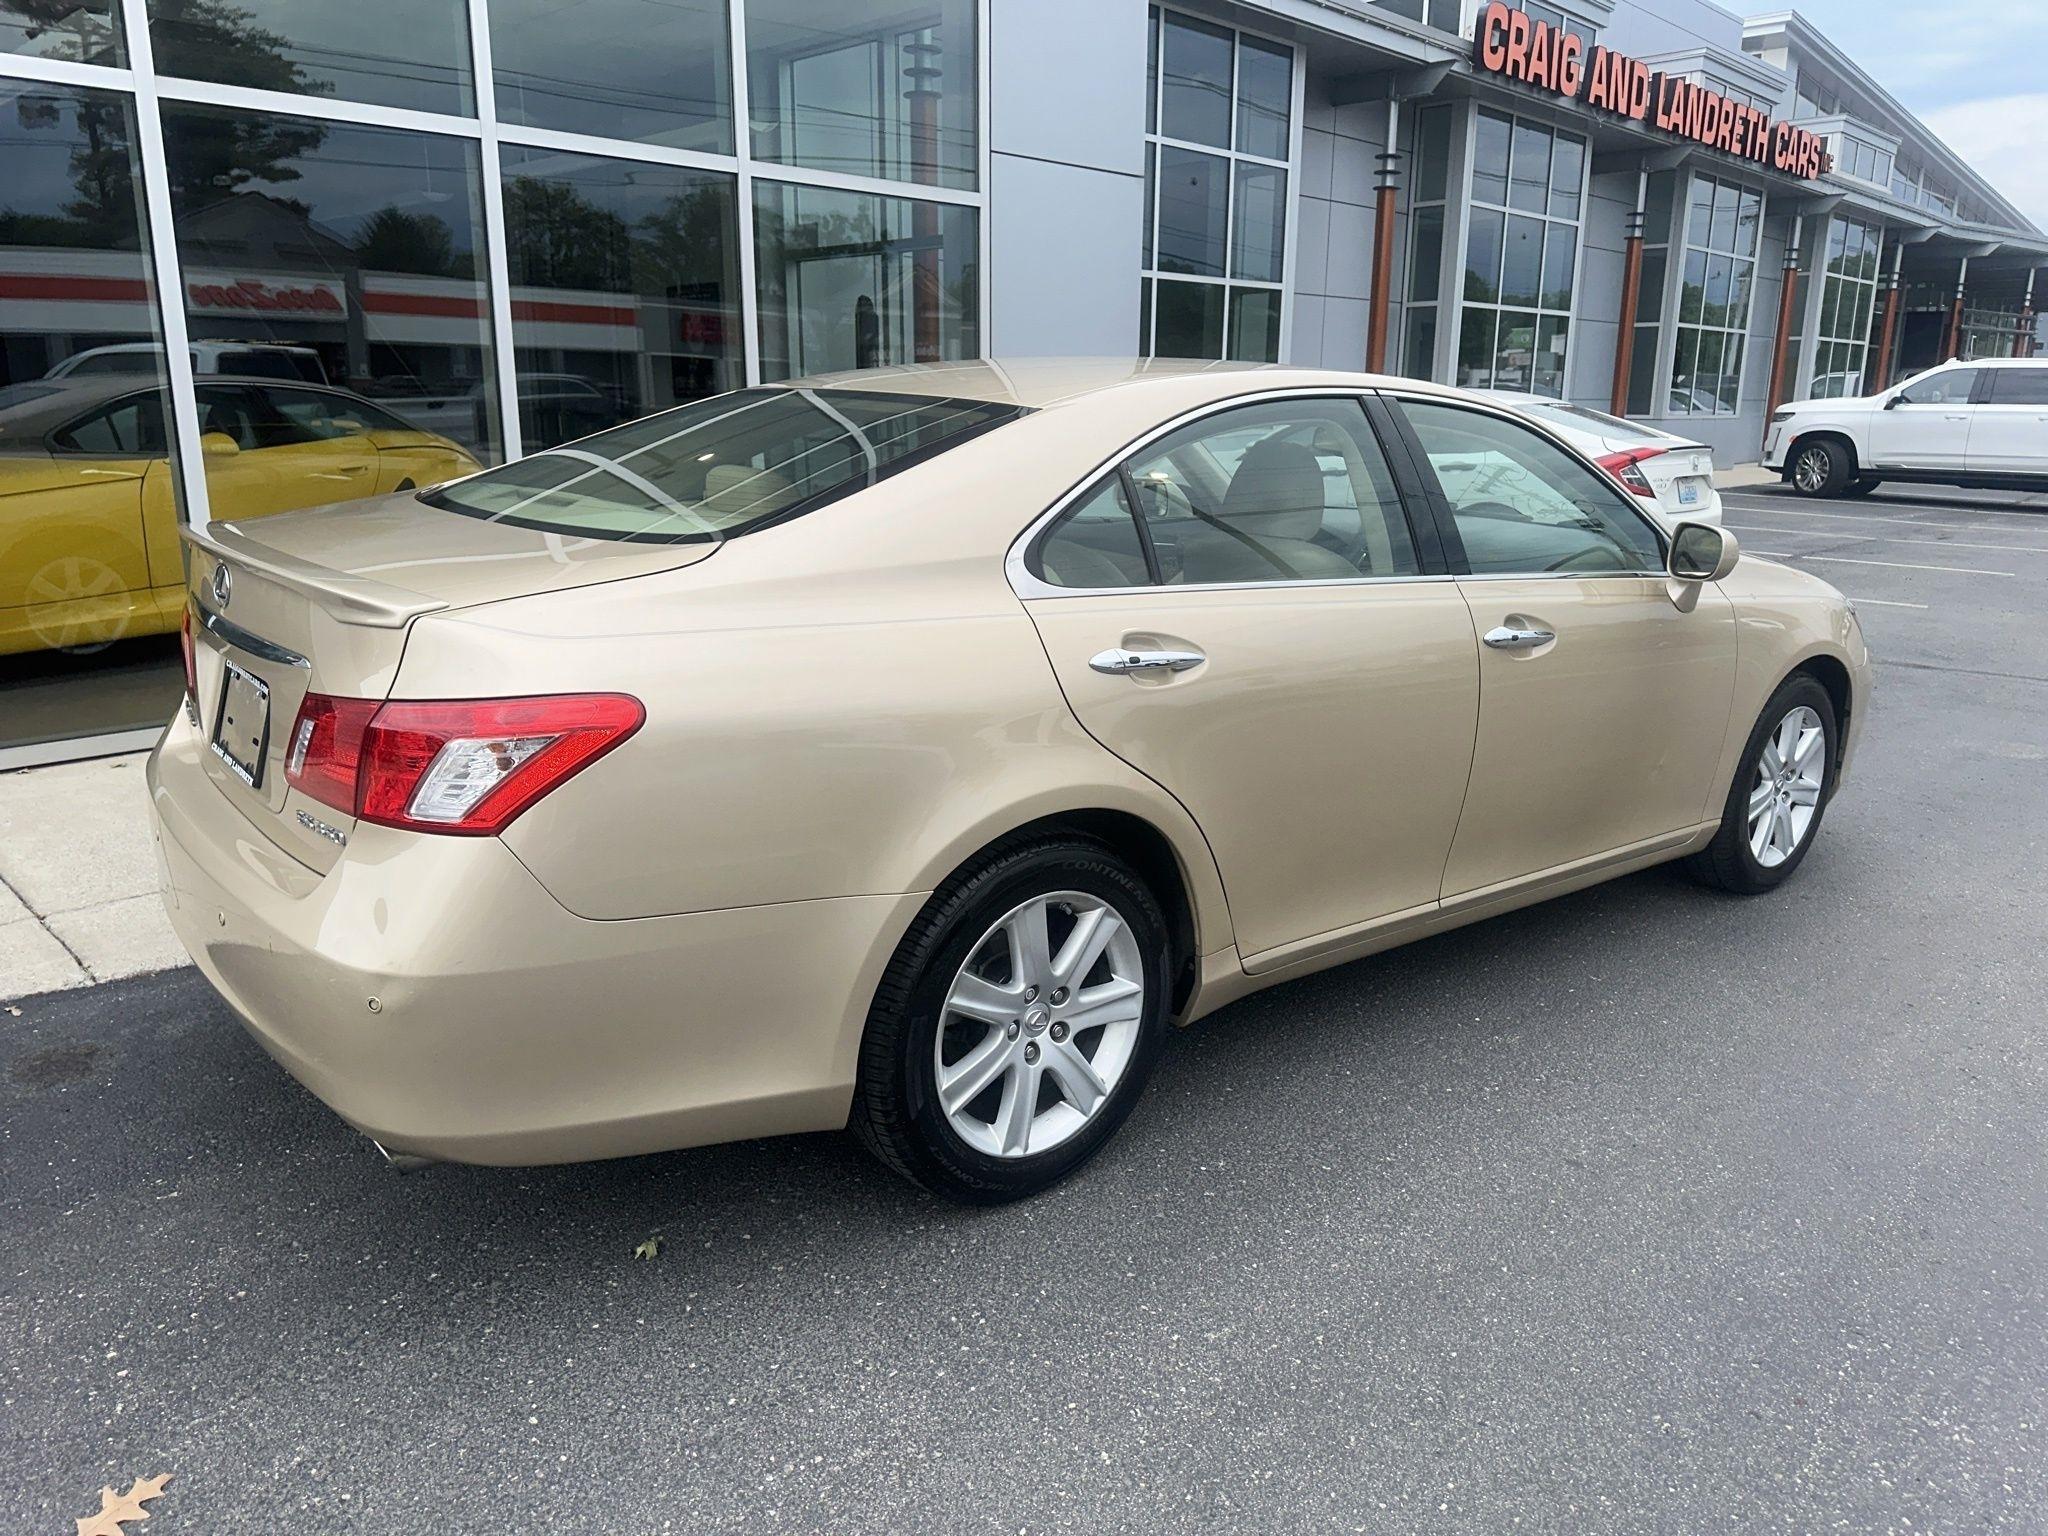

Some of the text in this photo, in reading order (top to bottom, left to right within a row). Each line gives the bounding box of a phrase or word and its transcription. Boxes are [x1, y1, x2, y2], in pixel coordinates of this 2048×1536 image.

[1481, 3, 1582, 97] CRAIG
[1588, 45, 1649, 121] AND
[1655, 71, 1771, 163] LANDRETH
[1774, 120, 1821, 180] CARS
